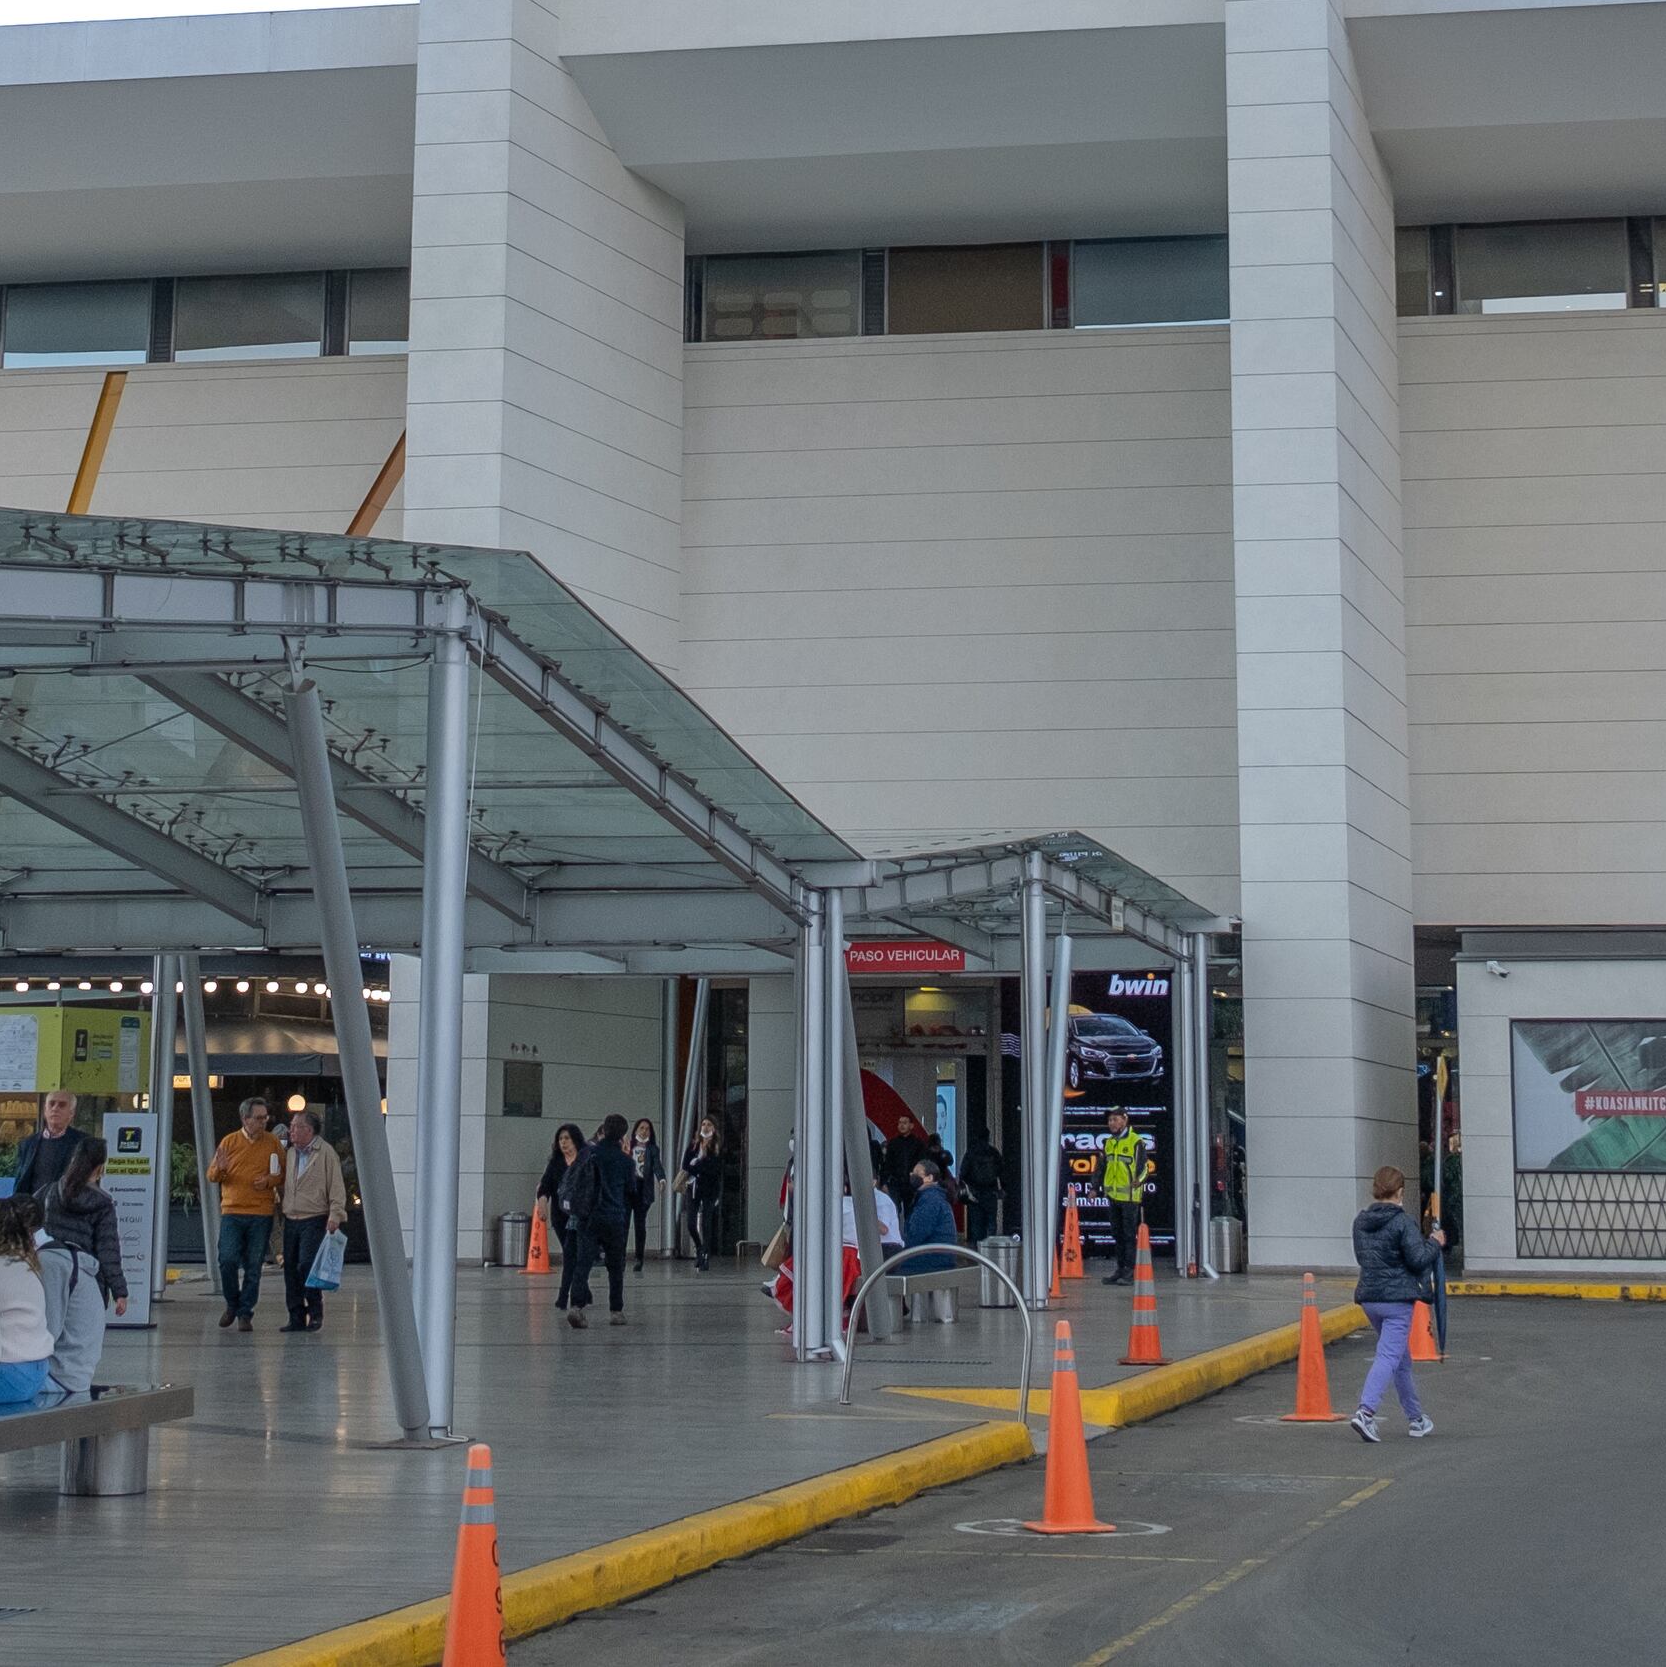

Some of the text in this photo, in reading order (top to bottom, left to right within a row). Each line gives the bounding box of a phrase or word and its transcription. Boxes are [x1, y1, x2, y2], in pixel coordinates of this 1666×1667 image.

[849, 949, 961, 962] PASO VEHICULAR
[1107, 972, 1170, 997] bwin
